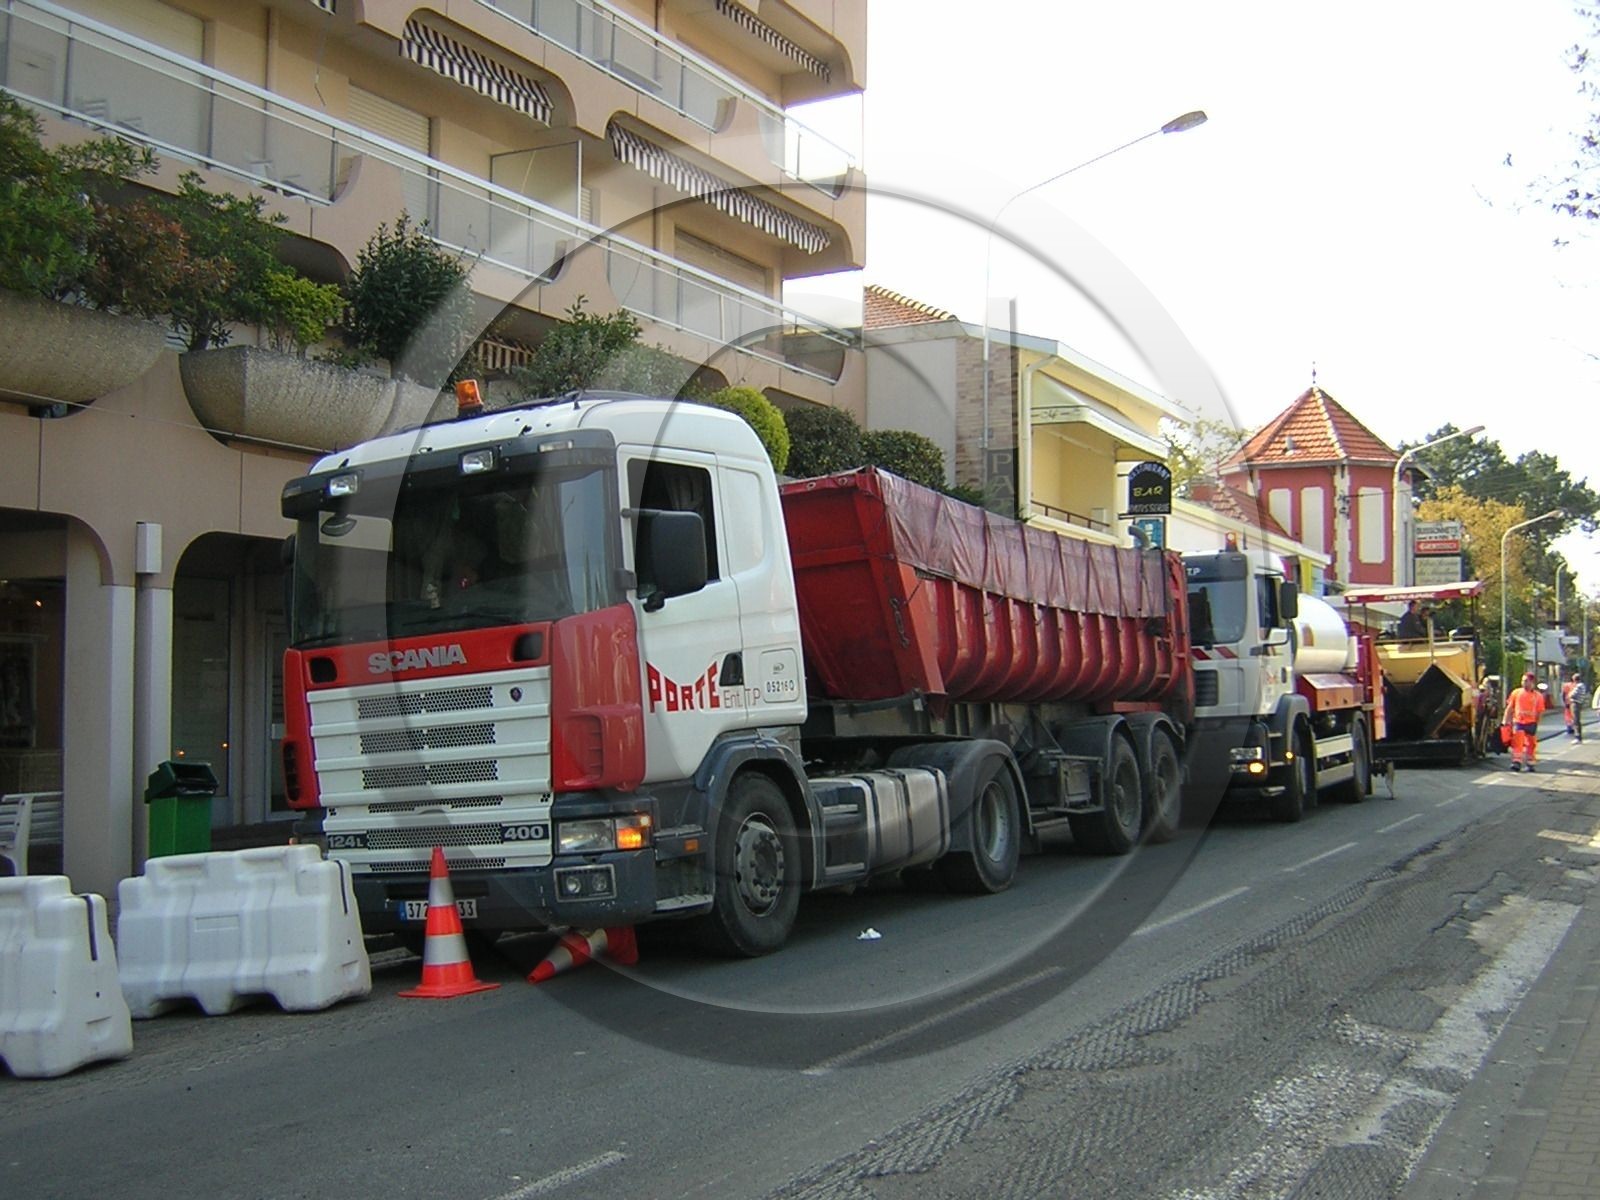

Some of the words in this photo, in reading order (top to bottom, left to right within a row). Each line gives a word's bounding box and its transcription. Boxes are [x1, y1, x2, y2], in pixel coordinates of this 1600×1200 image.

[1133, 485, 1164, 497] BAR
[368, 644, 467, 673] SCANIA
[645, 660, 721, 714] PORTE
[504, 825, 544, 840] 400
